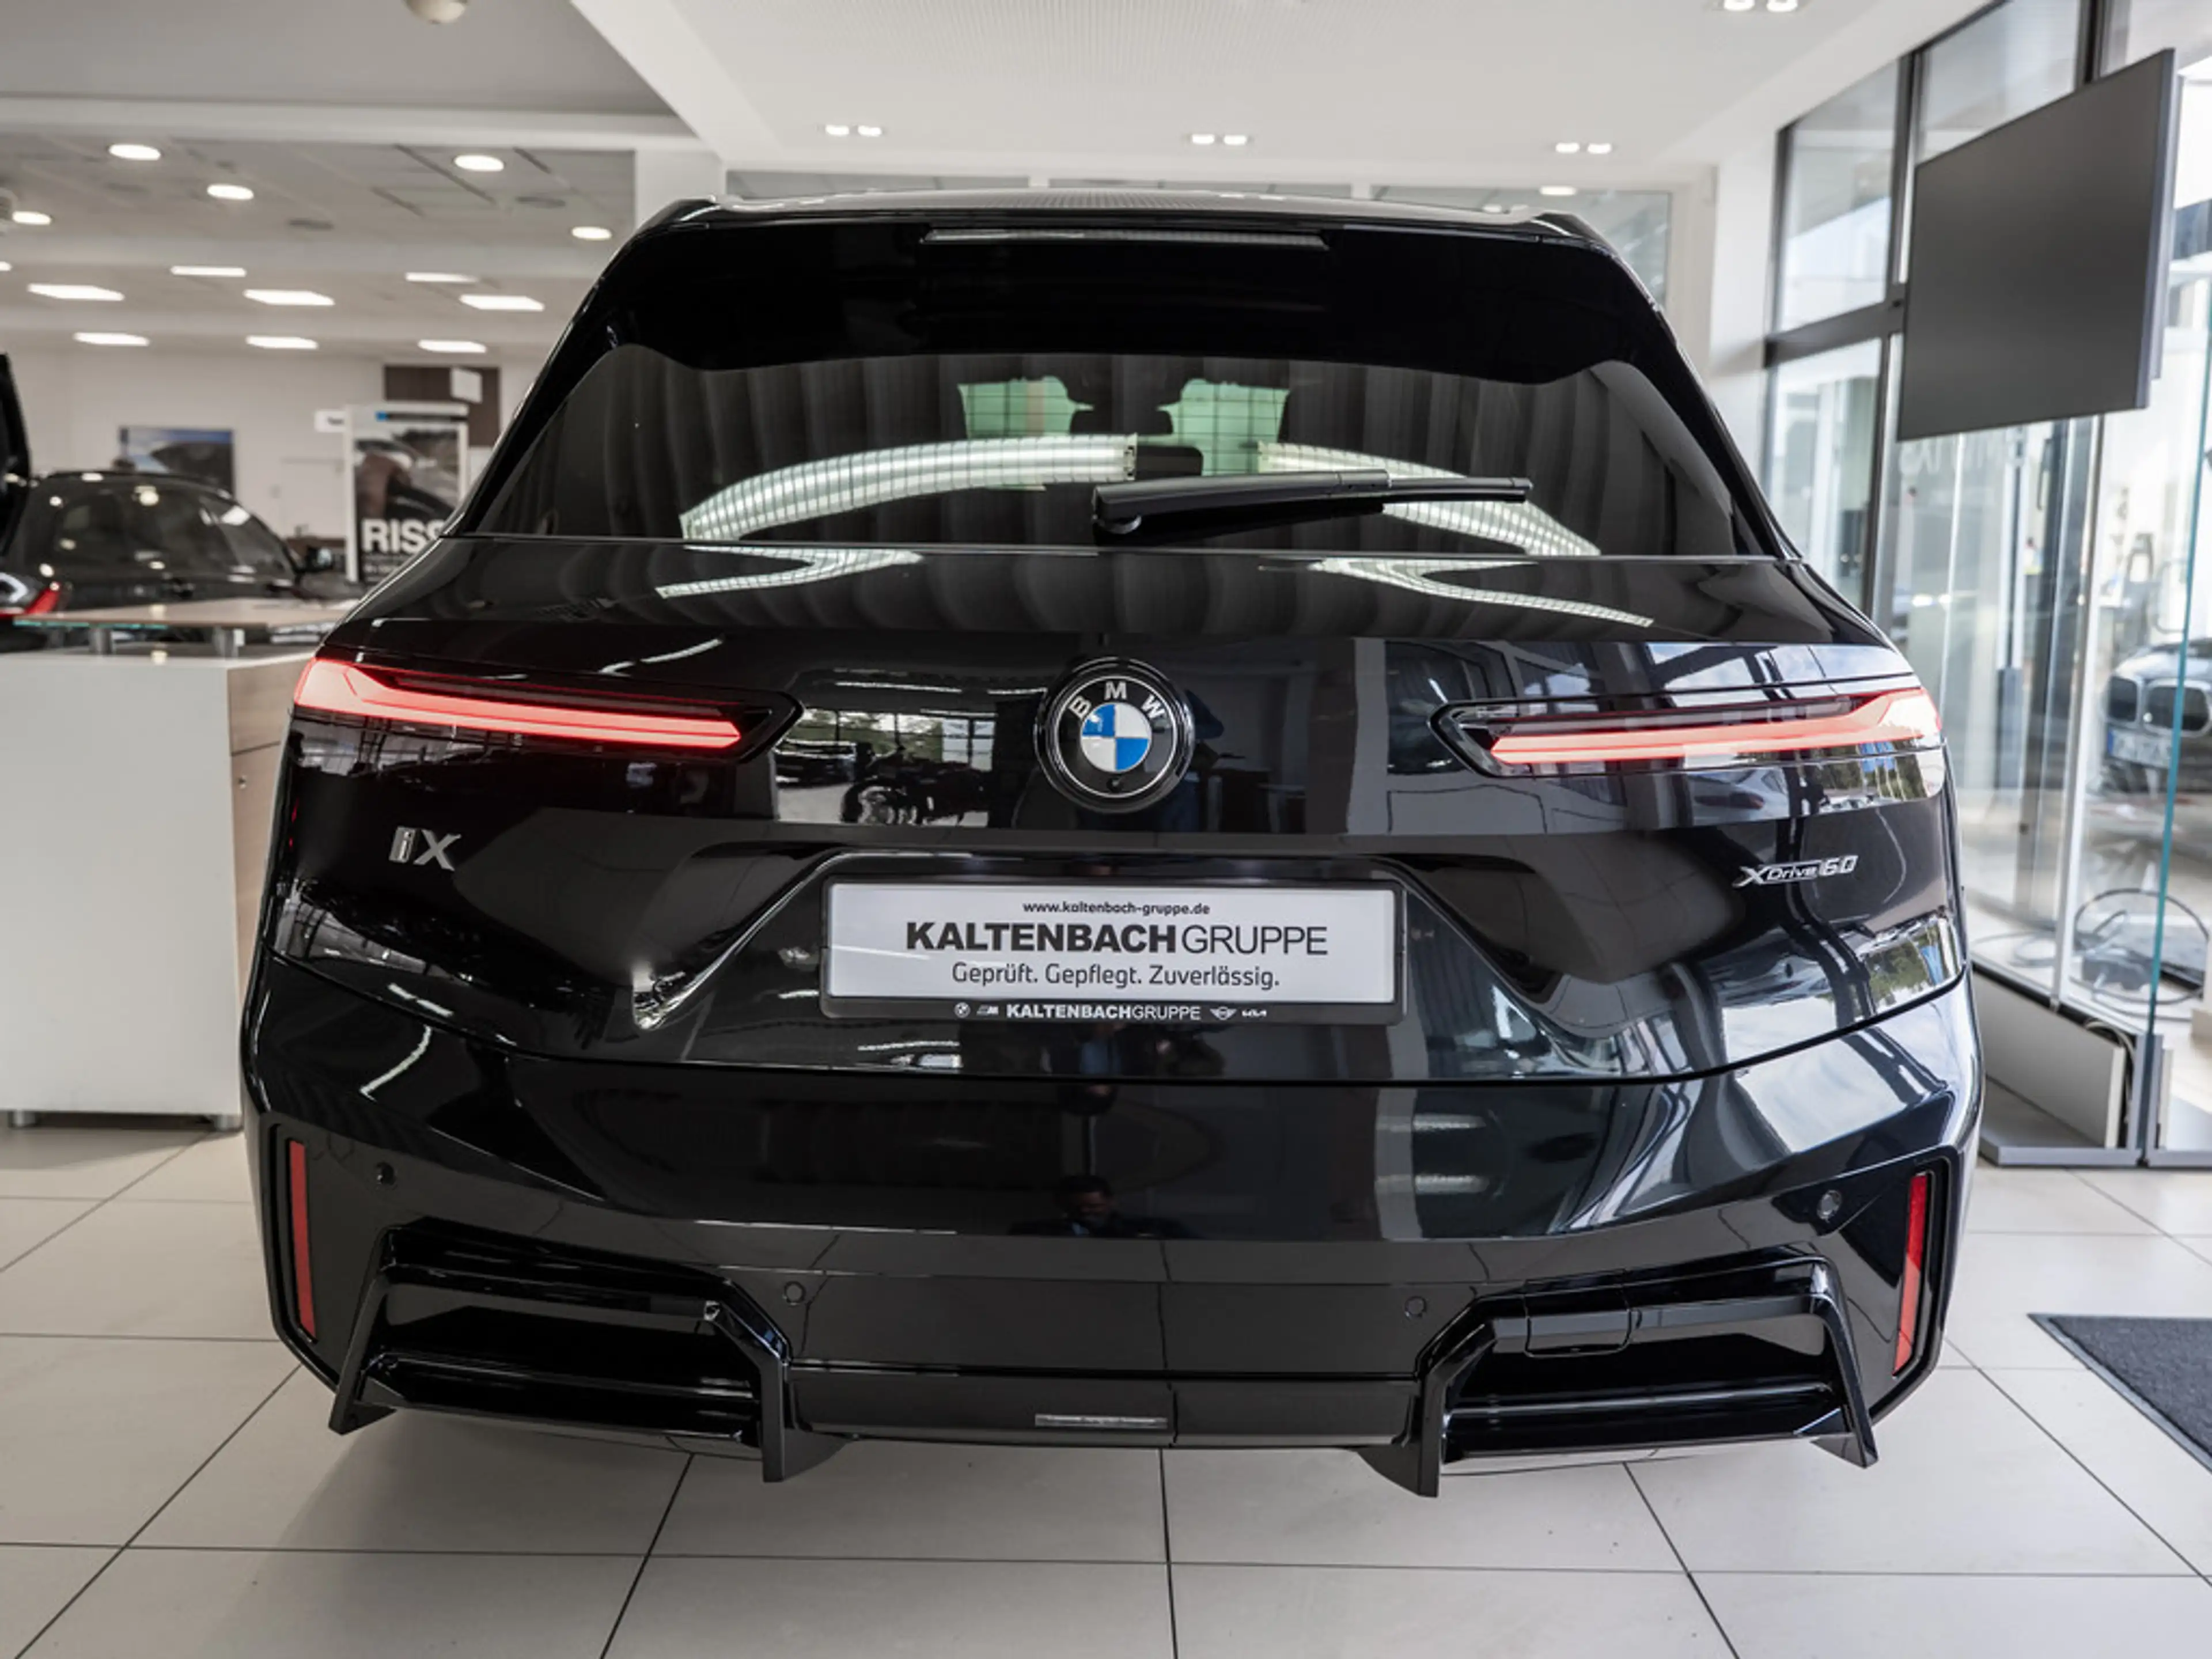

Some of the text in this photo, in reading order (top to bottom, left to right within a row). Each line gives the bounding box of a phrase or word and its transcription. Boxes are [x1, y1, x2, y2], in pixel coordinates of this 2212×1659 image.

[1068, 681, 1166, 720] BMW
[388, 825, 462, 872] iX
[1022, 901, 1210, 916] www.kaltenbach-gruppe.de
[952, 961, 1280, 991] Geprüft. Gepflegt. Zuverlässig.
